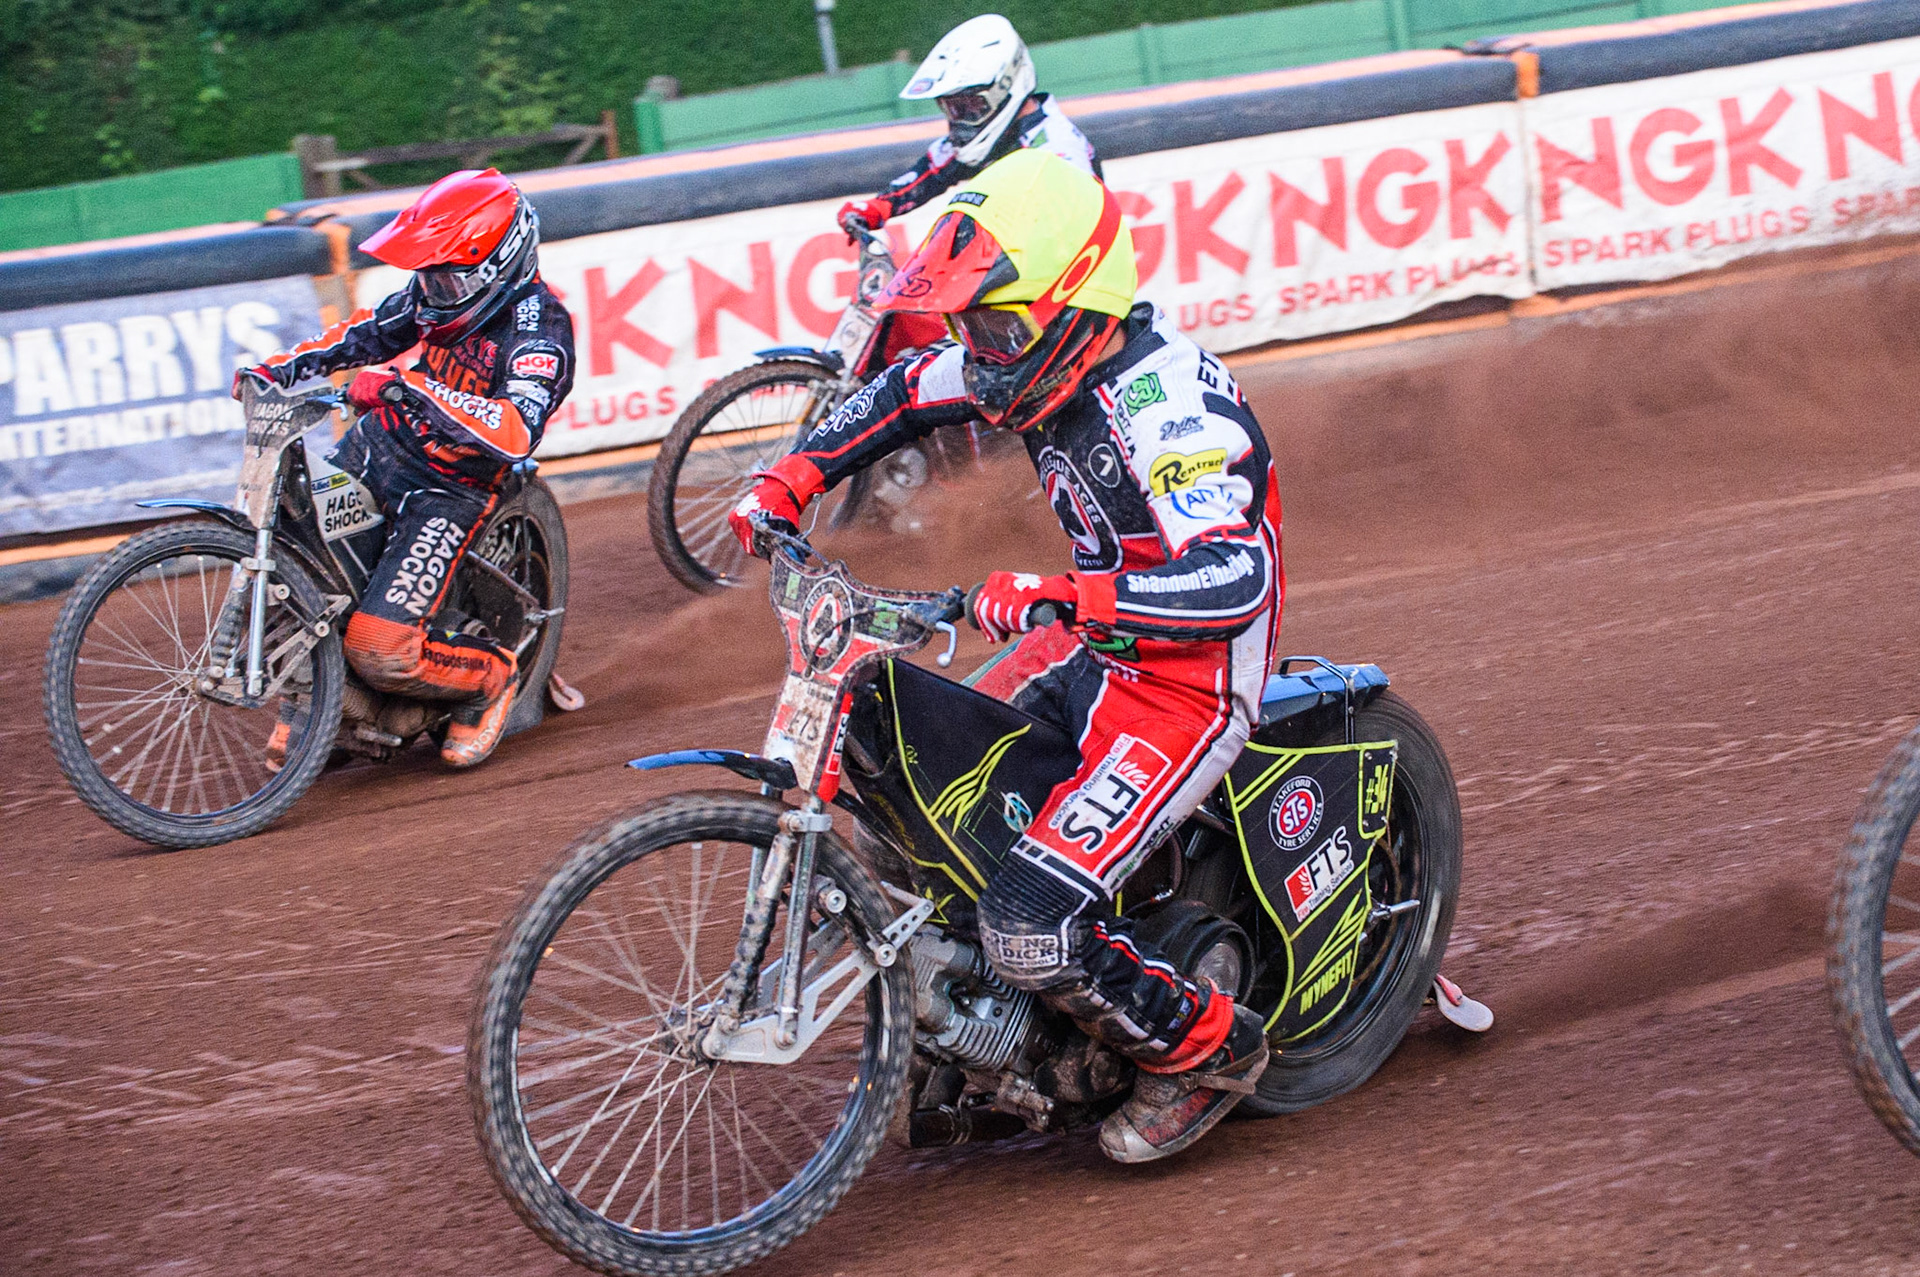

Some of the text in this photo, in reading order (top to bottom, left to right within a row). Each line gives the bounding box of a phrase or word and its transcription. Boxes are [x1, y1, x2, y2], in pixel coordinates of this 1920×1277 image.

[1535, 86, 1803, 224] NGK
[1268, 130, 1513, 268] NGK
[1544, 205, 1811, 268] SPARK PLUGS
[1278, 252, 1521, 315] SPARK PLUGS
[516, 356, 556, 371] NGK
[385, 516, 449, 605] SHOCKS
[404, 522, 466, 616] HAGON
[1083, 754, 1118, 792] Training
[1112, 735, 1132, 755] Fire
[1061, 773, 1141, 852] FTS
[1282, 795, 1309, 833] STS
[1306, 827, 1350, 892] FTS
[1002, 936, 1056, 949] KNG
